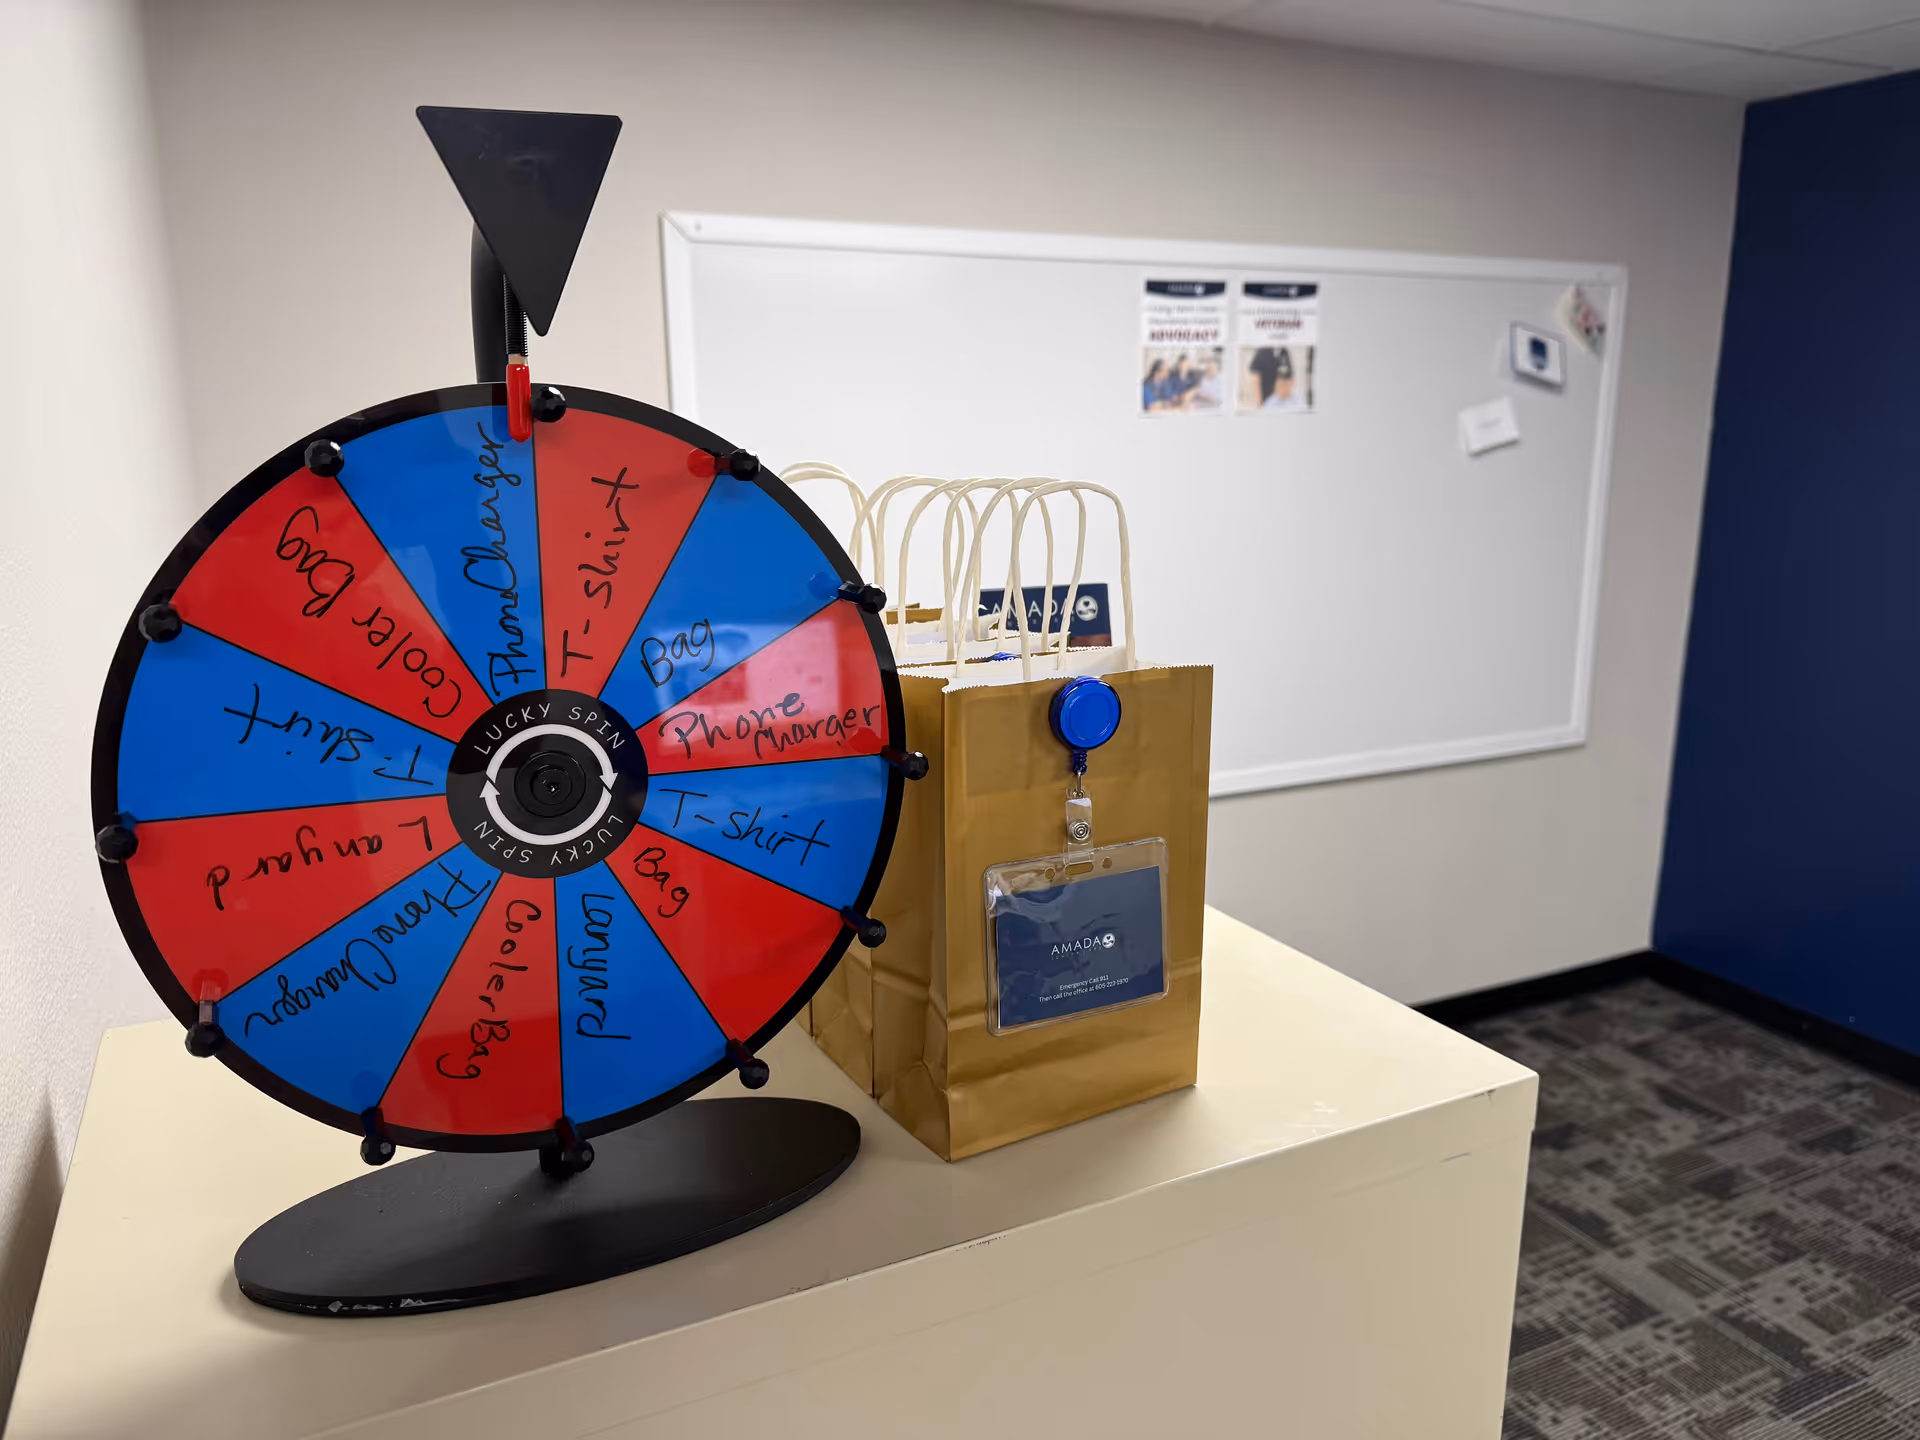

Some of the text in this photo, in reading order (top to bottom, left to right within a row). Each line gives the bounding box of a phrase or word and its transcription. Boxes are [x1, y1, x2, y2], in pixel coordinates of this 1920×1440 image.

[461, 421, 522, 593] Charger
[276, 505, 463, 719] Cooler Bag
[640, 618, 717, 689] Bag
[473, 702, 626, 755] LUCKY SPIN
[658, 691, 806, 760] Phone
[206, 815, 434, 912] Lanyard
[473, 814, 625, 866] LUCKY SPIN
[632, 846, 690, 918] Bag
[244, 860, 492, 1038] Phone Charger
[567, 893, 631, 1040] Lanyard
[1051, 936, 1101, 956] AMADA
[435, 899, 543, 1080] Cooler Bag
[1039, 995, 1053, 1003] Then
[1053, 992, 1063, 1000] call
[1073, 986, 1088, 995] office
[1059, 979, 1089, 991] Emergency
[1089, 976, 1099, 984] Call
